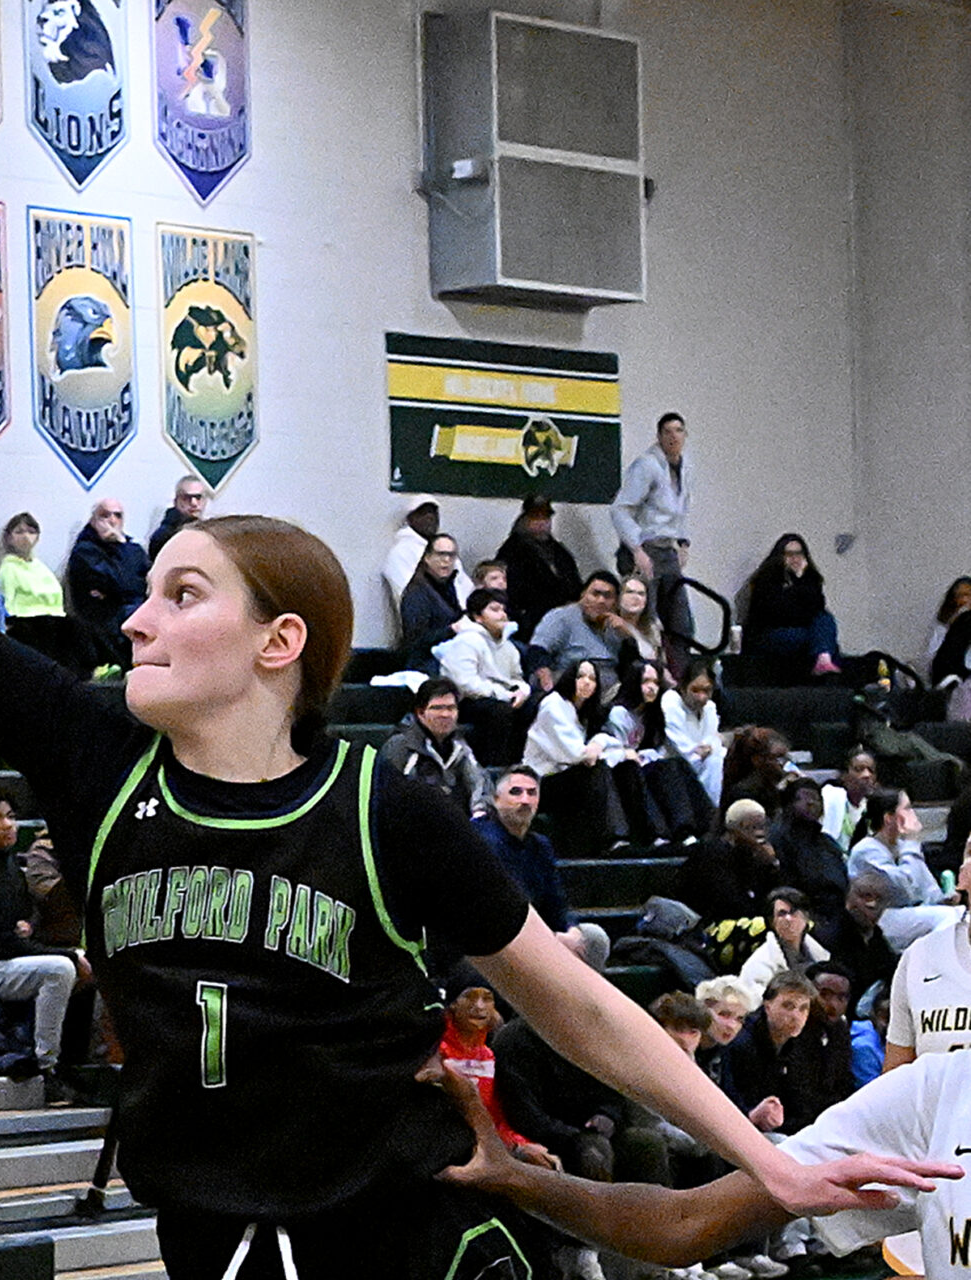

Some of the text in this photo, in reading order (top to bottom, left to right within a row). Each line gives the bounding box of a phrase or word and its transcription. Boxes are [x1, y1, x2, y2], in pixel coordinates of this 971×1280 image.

[32, 72, 124, 156] LIONS
[39, 374, 133, 452] HAWKS
[264, 873, 356, 983] PARK
[196, 980, 227, 1088] 1
